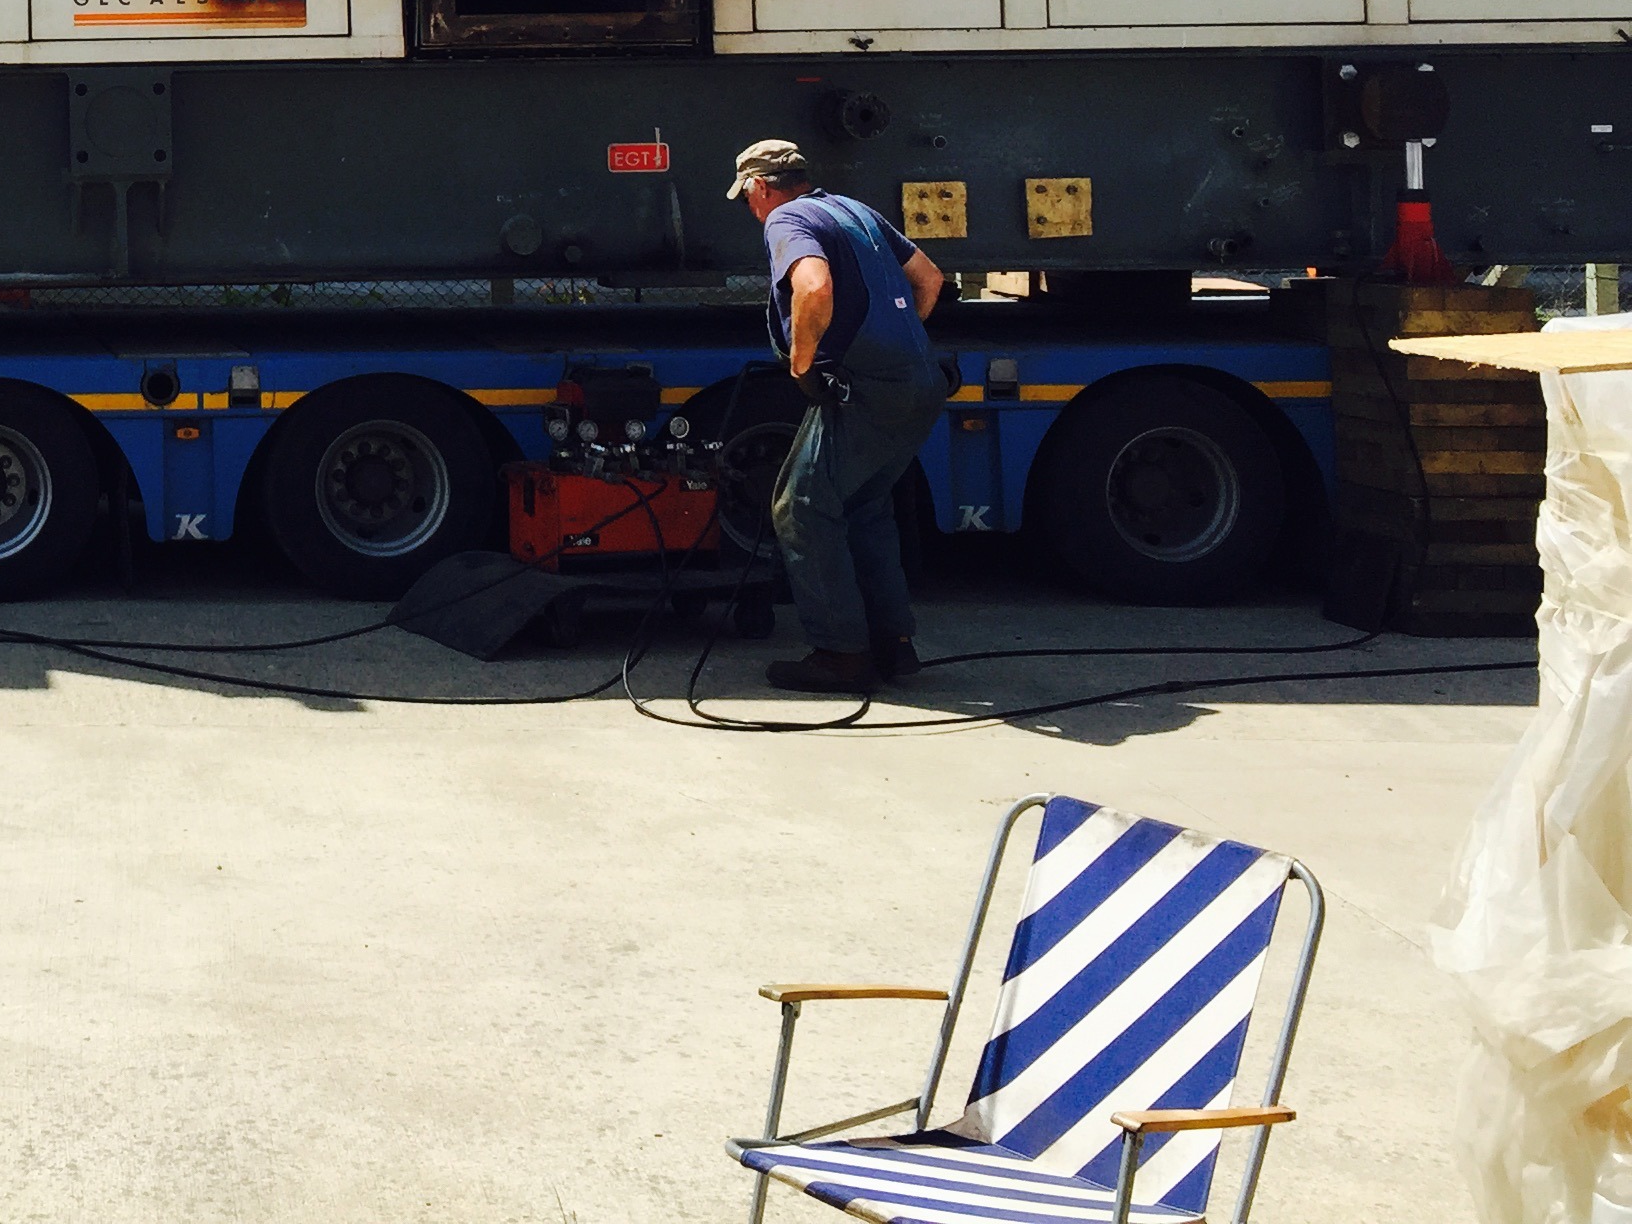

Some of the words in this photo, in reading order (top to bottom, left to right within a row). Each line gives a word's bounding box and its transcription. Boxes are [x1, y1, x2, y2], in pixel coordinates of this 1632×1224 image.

[614, 151, 650, 167] EGT
[686, 479, 709, 491] Yale
[171, 513, 209, 540] K
[956, 505, 992, 531] K
